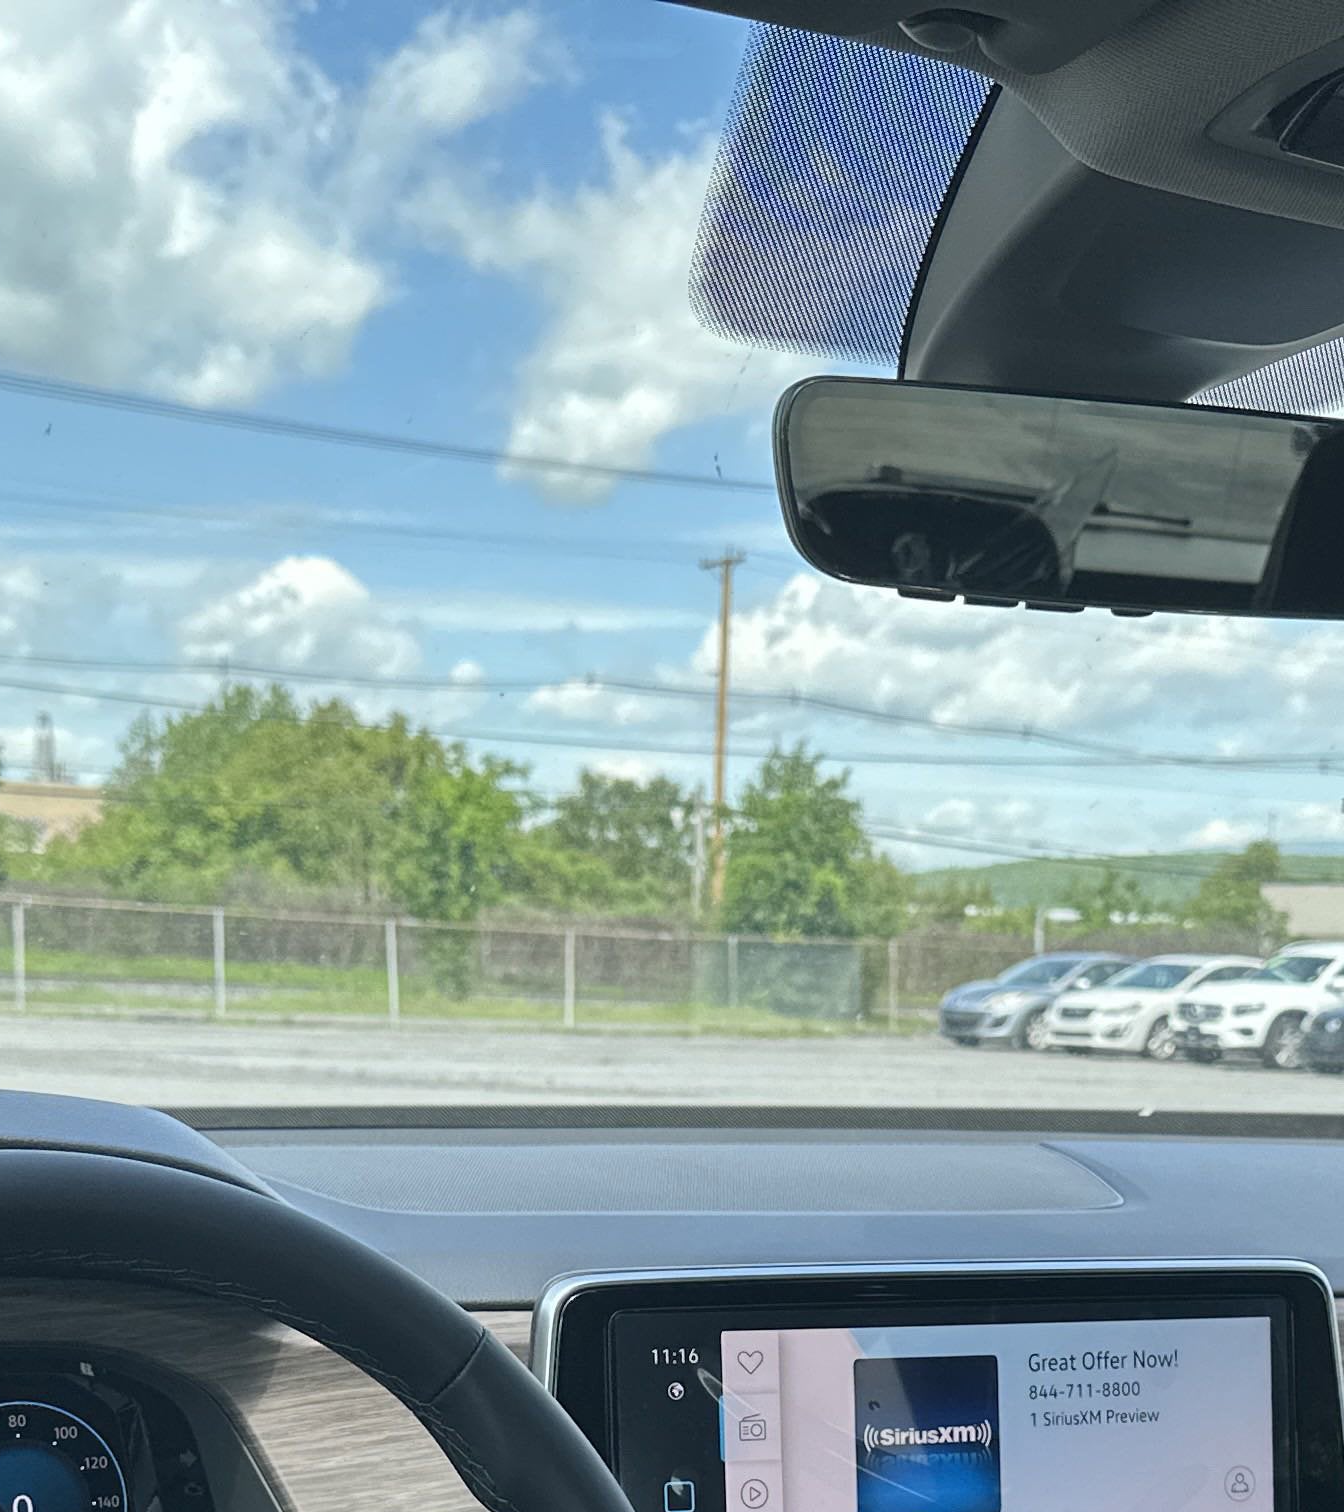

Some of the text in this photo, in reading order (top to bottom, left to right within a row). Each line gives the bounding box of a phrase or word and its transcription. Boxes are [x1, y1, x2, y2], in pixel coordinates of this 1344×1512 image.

[651, 1348, 699, 1365] 11:16
[1028, 1349, 1179, 1372] Great Offer Now!
[1028, 1381, 1141, 1400] 844-711-8800
[8, 1414, 27, 1427] 80
[1030, 1408, 1160, 1427] 1 SiriusXM Preview
[54, 1426, 78, 1440] 100
[84, 1456, 108, 1469] 120
[97, 1496, 120, 1508] 140
